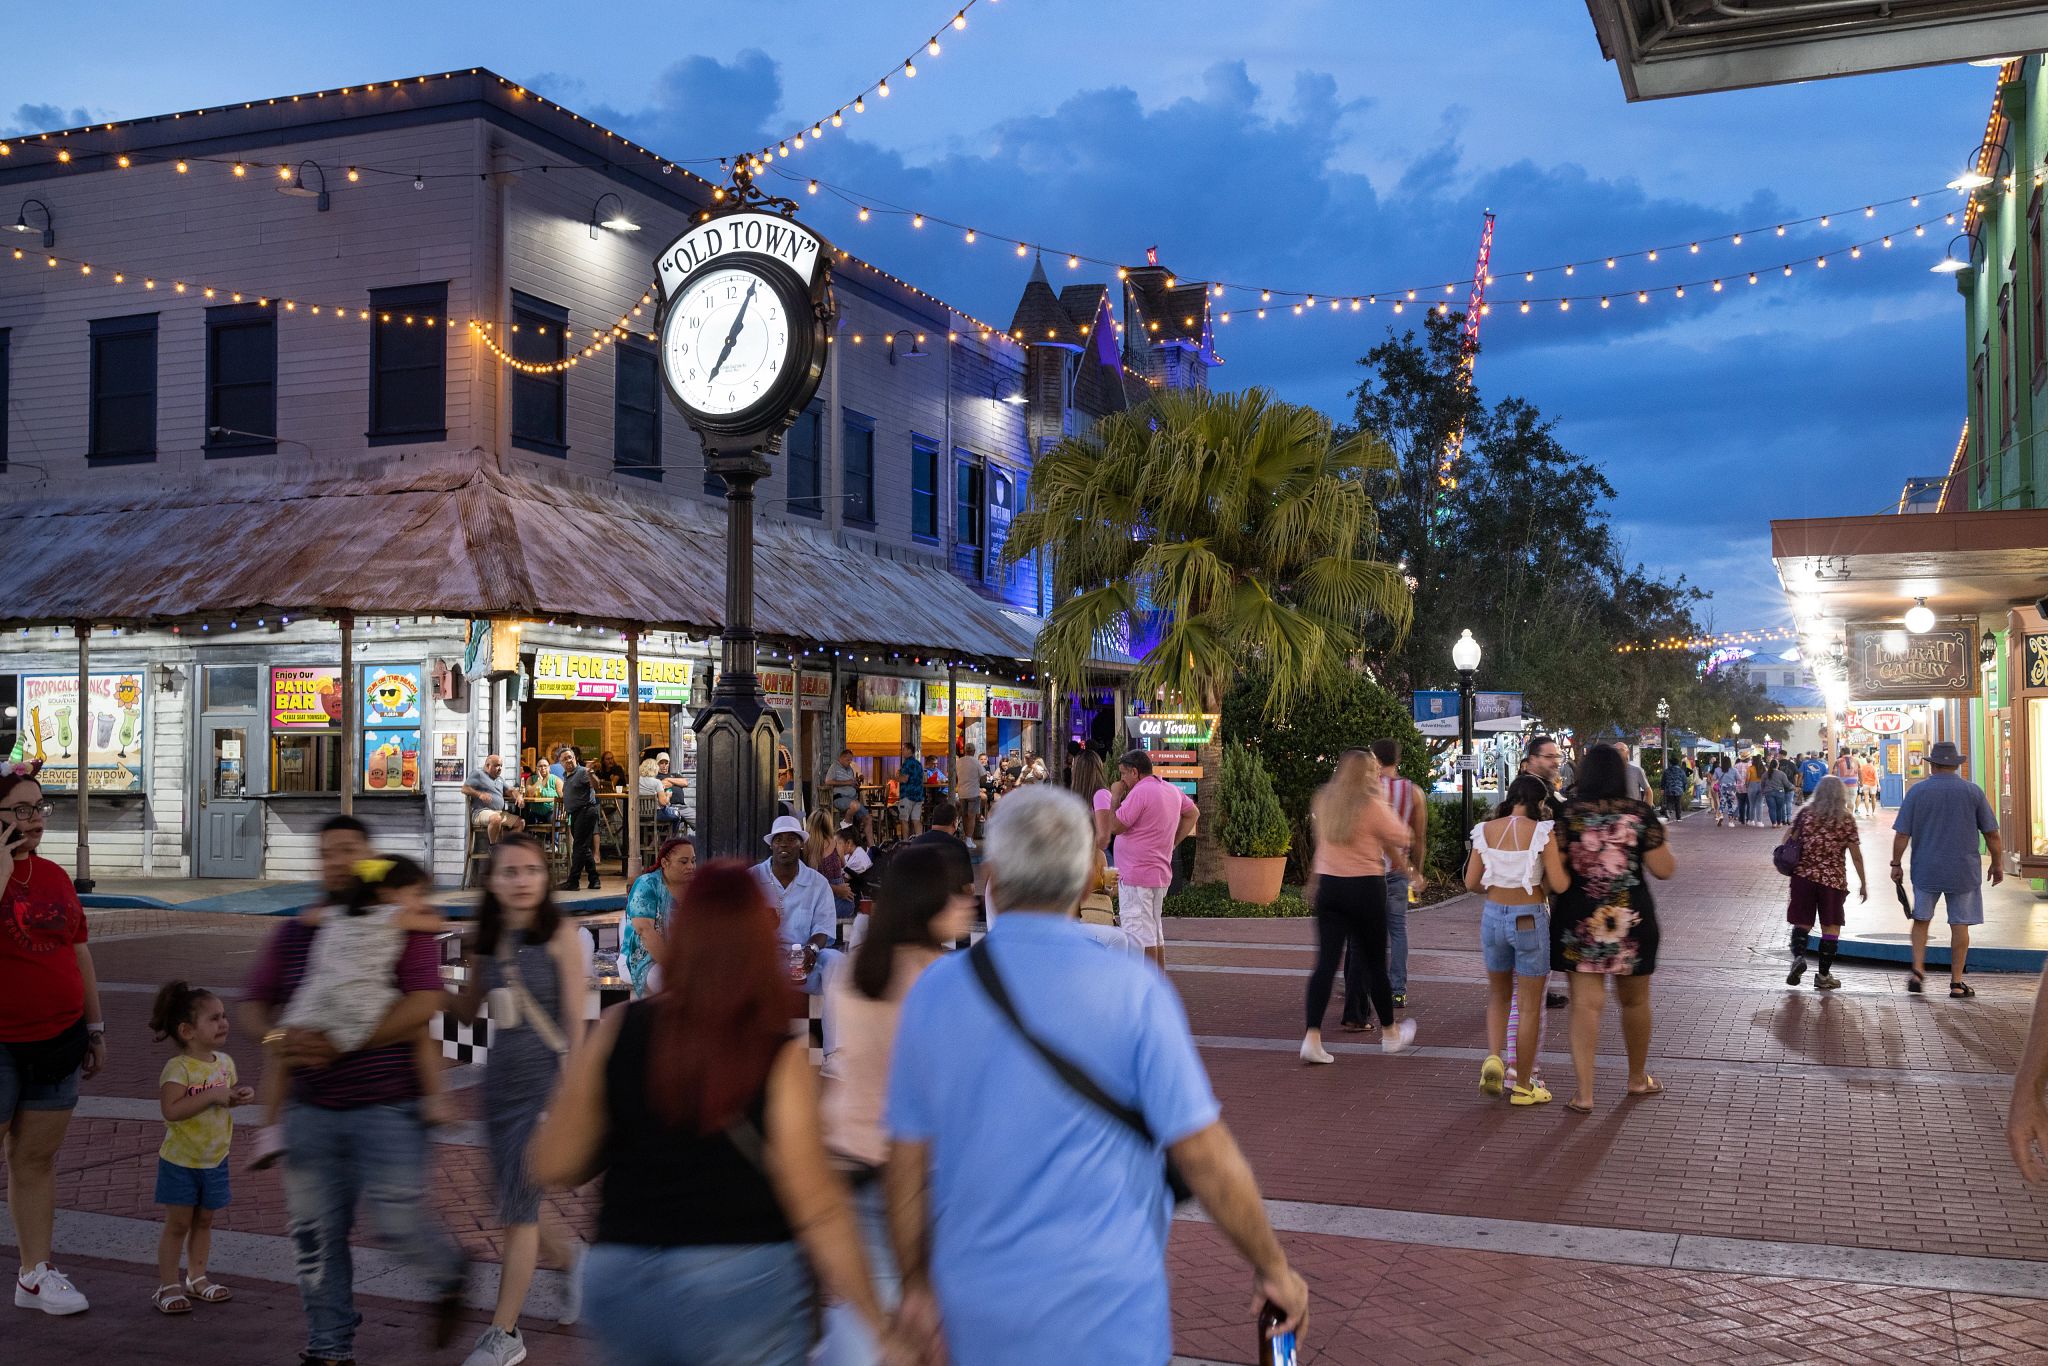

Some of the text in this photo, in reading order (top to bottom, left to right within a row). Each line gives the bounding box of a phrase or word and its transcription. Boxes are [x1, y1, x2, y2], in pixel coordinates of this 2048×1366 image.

[726, 286, 738, 299] 12
[705, 296, 714, 309] 11
[769, 307, 776, 321] 2
[689, 316, 700, 329] 10
[777, 332, 785, 346] 3
[681, 343, 689, 356] 9
[769, 359, 776, 373] 4
[689, 368, 696, 380] 8
[706, 385, 713, 398] 7
[752, 380, 759, 394] 5
[728, 391, 736, 403] 6
[275, 670, 314, 680] Enjoy Our
[538, 653, 689, 685] #1 FOR 23 EARS!
[1880, 662, 1949, 680] GALLERY
[26, 678, 111, 699] TROPICAL DNKS
[275, 680, 317, 694] PATIO
[780, 673, 793, 694] TH
[275, 693, 316, 710] BAR
[993, 698, 1012, 717] OPEN
[1028, 702, 1039, 719] AM
[1478, 704, 1505, 713] whole
[1139, 720, 1197, 735] Old Town
[1875, 719, 1900, 731] TV
[37, 770, 77, 779] SERVICE
